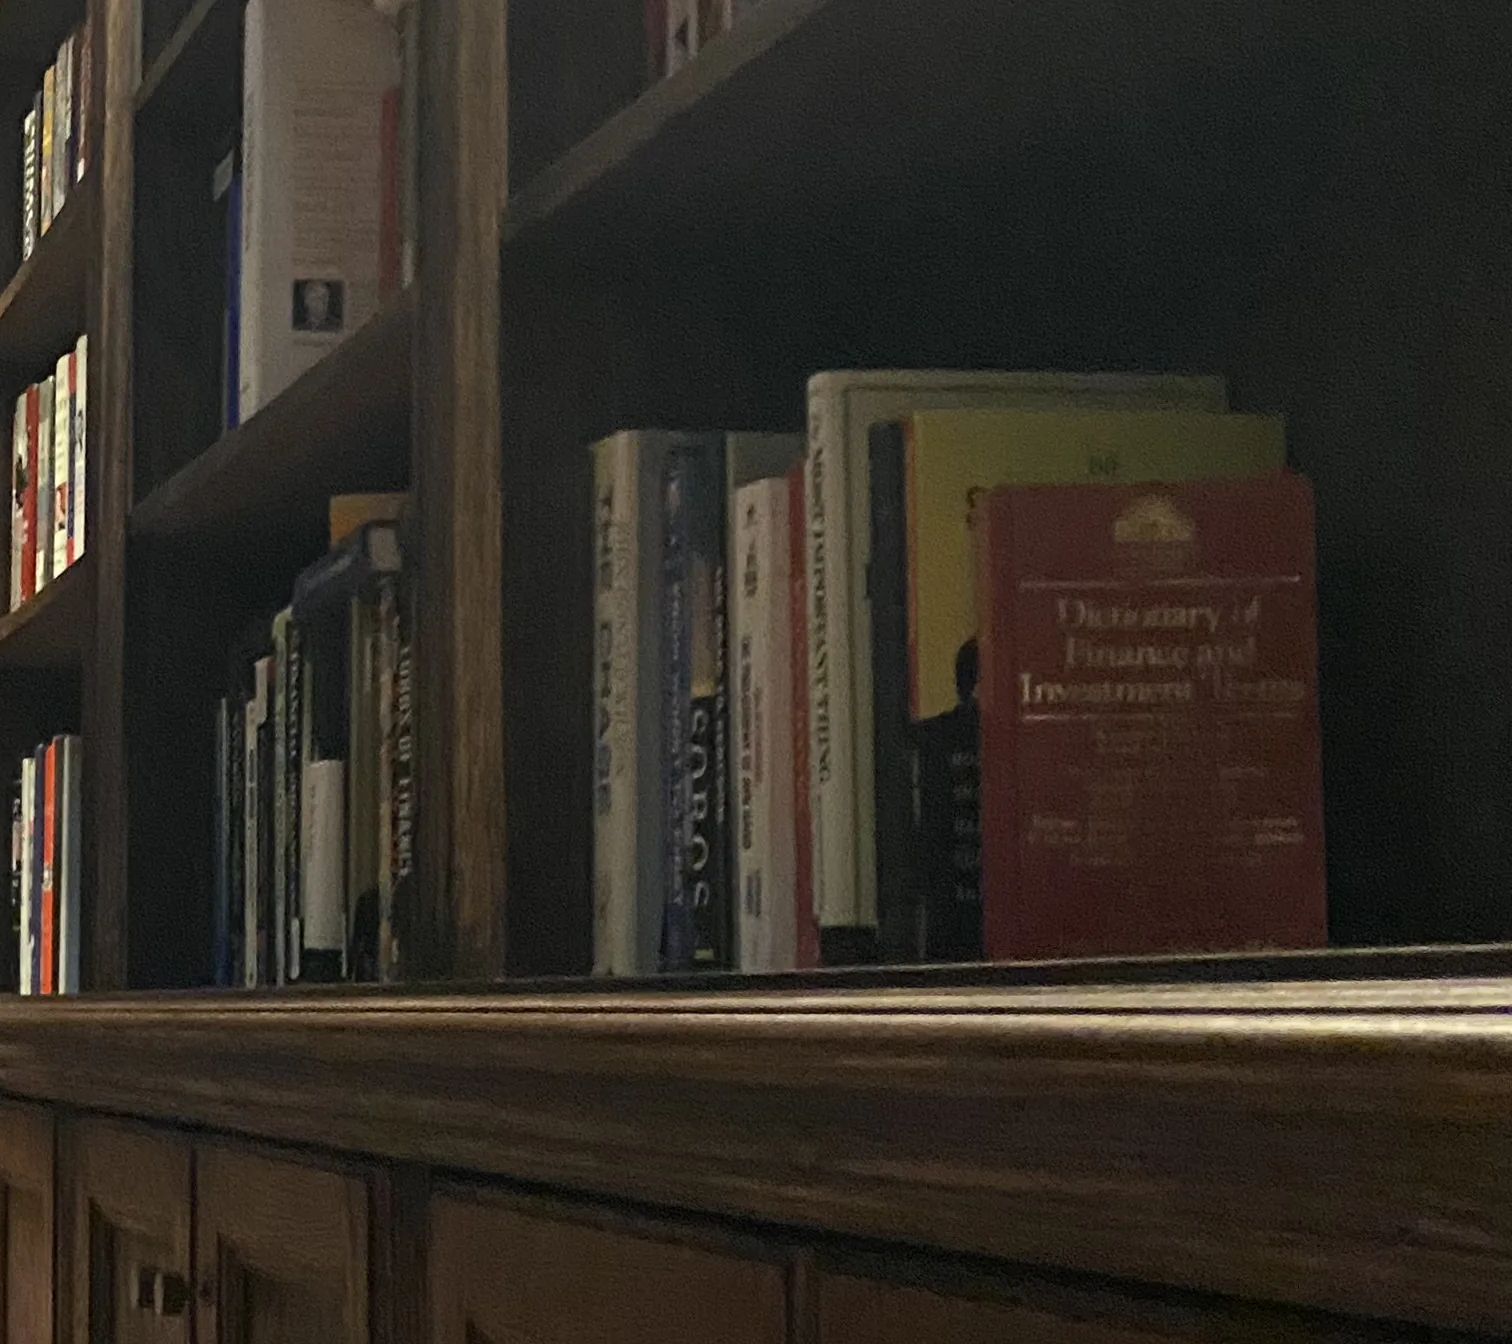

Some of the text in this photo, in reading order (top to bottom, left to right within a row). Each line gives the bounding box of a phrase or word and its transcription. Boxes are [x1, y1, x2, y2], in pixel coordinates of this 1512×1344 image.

[813, 527, 829, 692] IMPORTANT
[1058, 598, 1221, 632] Dictionary
[1064, 637, 1188, 670] Finance
[1020, 671, 1192, 705] Investment
[685, 707, 712, 911] SOROS
